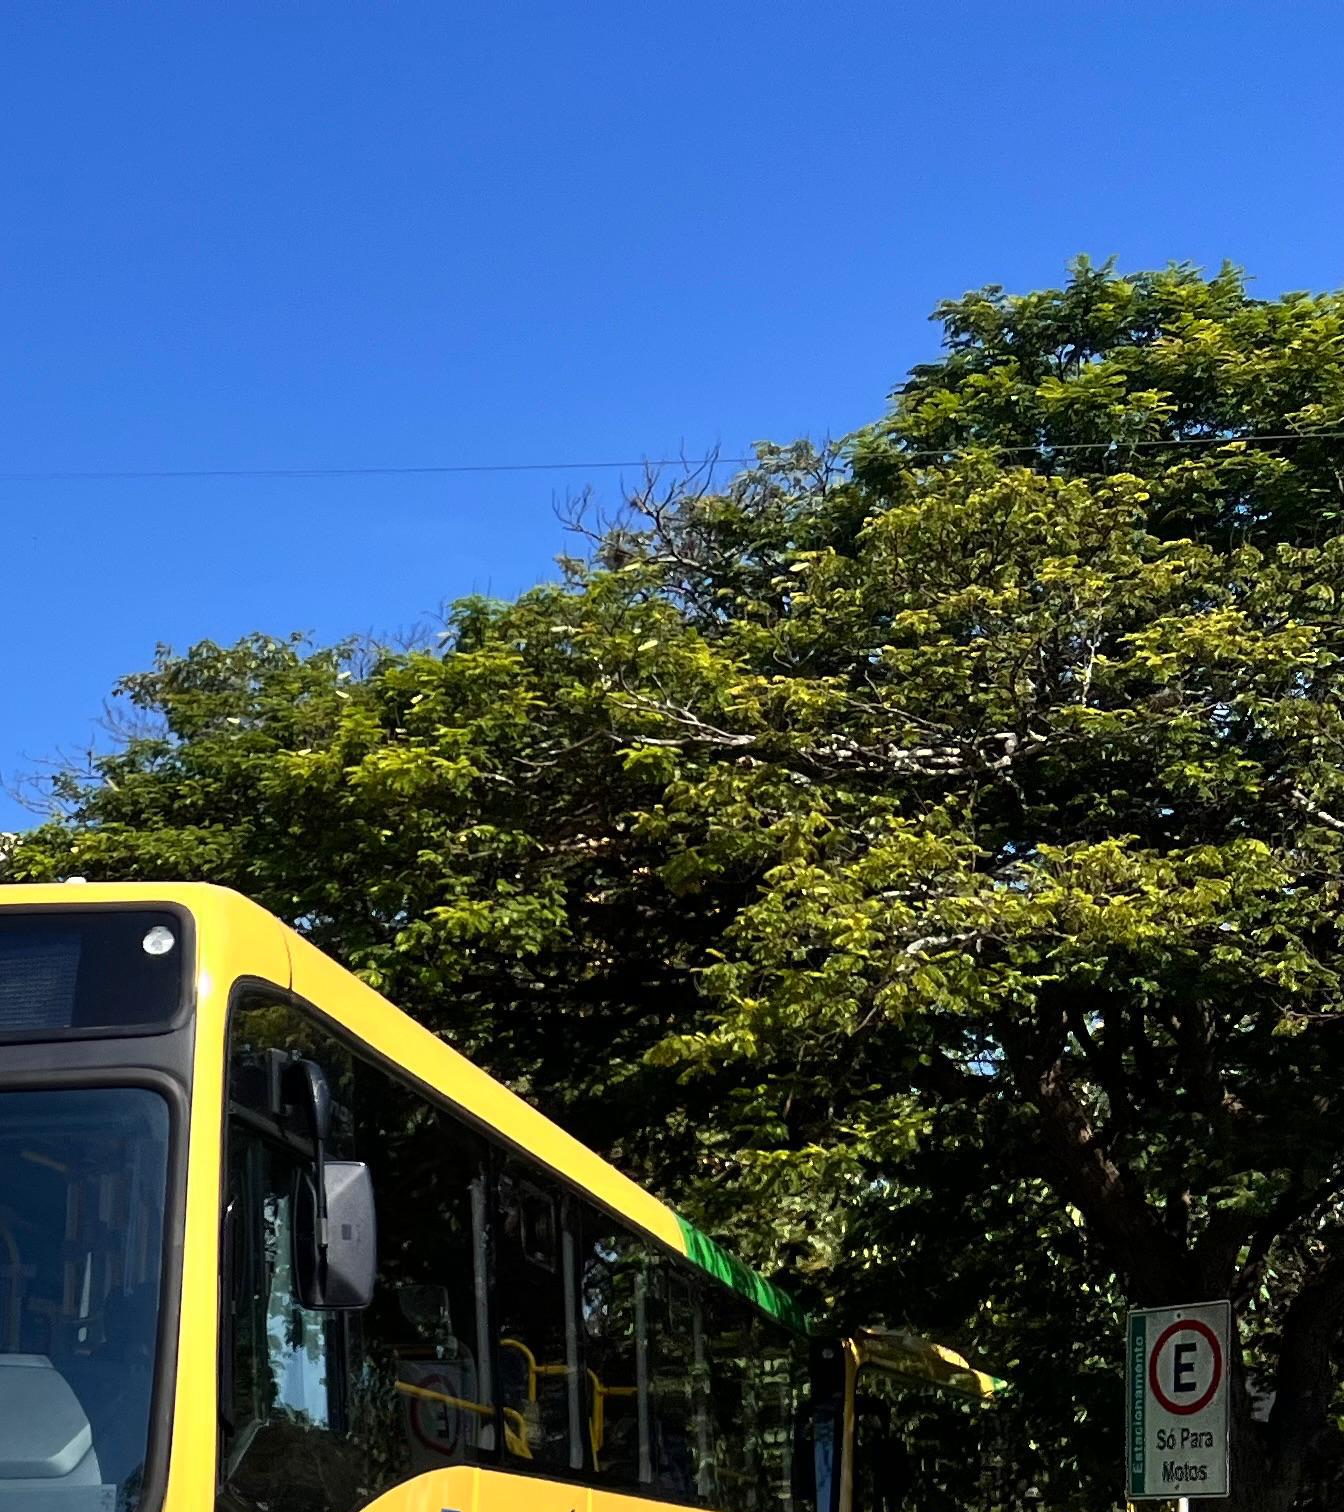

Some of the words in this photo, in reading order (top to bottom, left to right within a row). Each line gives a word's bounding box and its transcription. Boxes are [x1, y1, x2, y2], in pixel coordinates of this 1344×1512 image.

[1173, 1342, 1197, 1393] E
[1156, 1428, 1177, 1451] Só
[1180, 1428, 1213, 1450] Para
[1162, 1461, 1208, 1482] Motos
